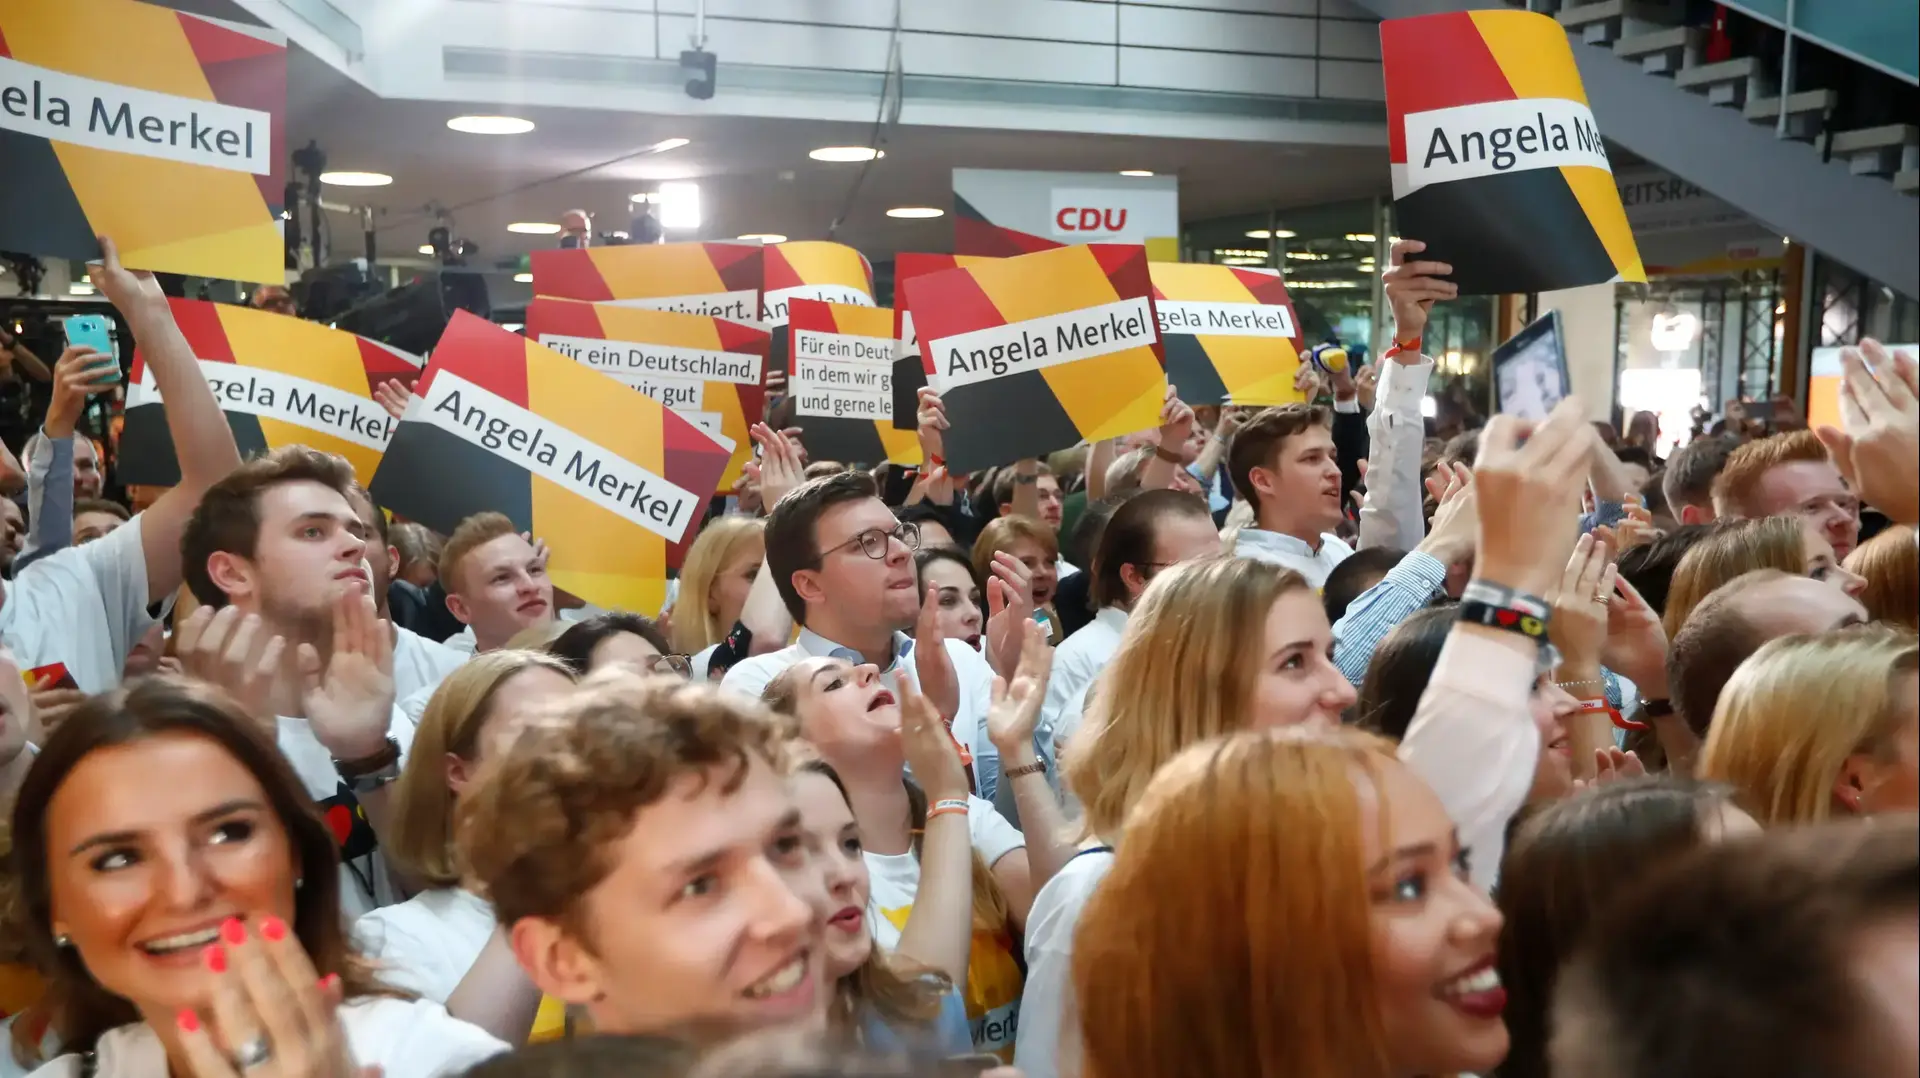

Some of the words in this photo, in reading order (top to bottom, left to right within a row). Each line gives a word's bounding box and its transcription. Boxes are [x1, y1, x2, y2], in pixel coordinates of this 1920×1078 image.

[1, 80, 71, 127] ela
[88, 97, 253, 158] Merkel
[1423, 112, 1569, 170] Angela
[1573, 116, 1606, 158] Me
[1056, 207, 1128, 232] CDU
[1157, 307, 1202, 332] gela
[1208, 309, 1285, 330] Merkel
[801, 336, 824, 354] Für
[828, 340, 850, 357] ein
[948, 331, 1049, 375] Angela
[1056, 307, 1147, 352] Merkel
[547, 341, 582, 361] ür
[588, 346, 620, 366] ein
[628, 349, 756, 382] Deutschland,
[801, 363, 814, 381] in
[818, 365, 850, 384] dem
[854, 369, 877, 386] wir
[663, 385, 696, 406] gut
[802, 394, 829, 410] und
[834, 399, 875, 416] gerne
[879, 397, 892, 413] le
[286, 387, 393, 442] Merkel
[434, 390, 558, 466] Angela
[563, 450, 683, 527] Merkel
